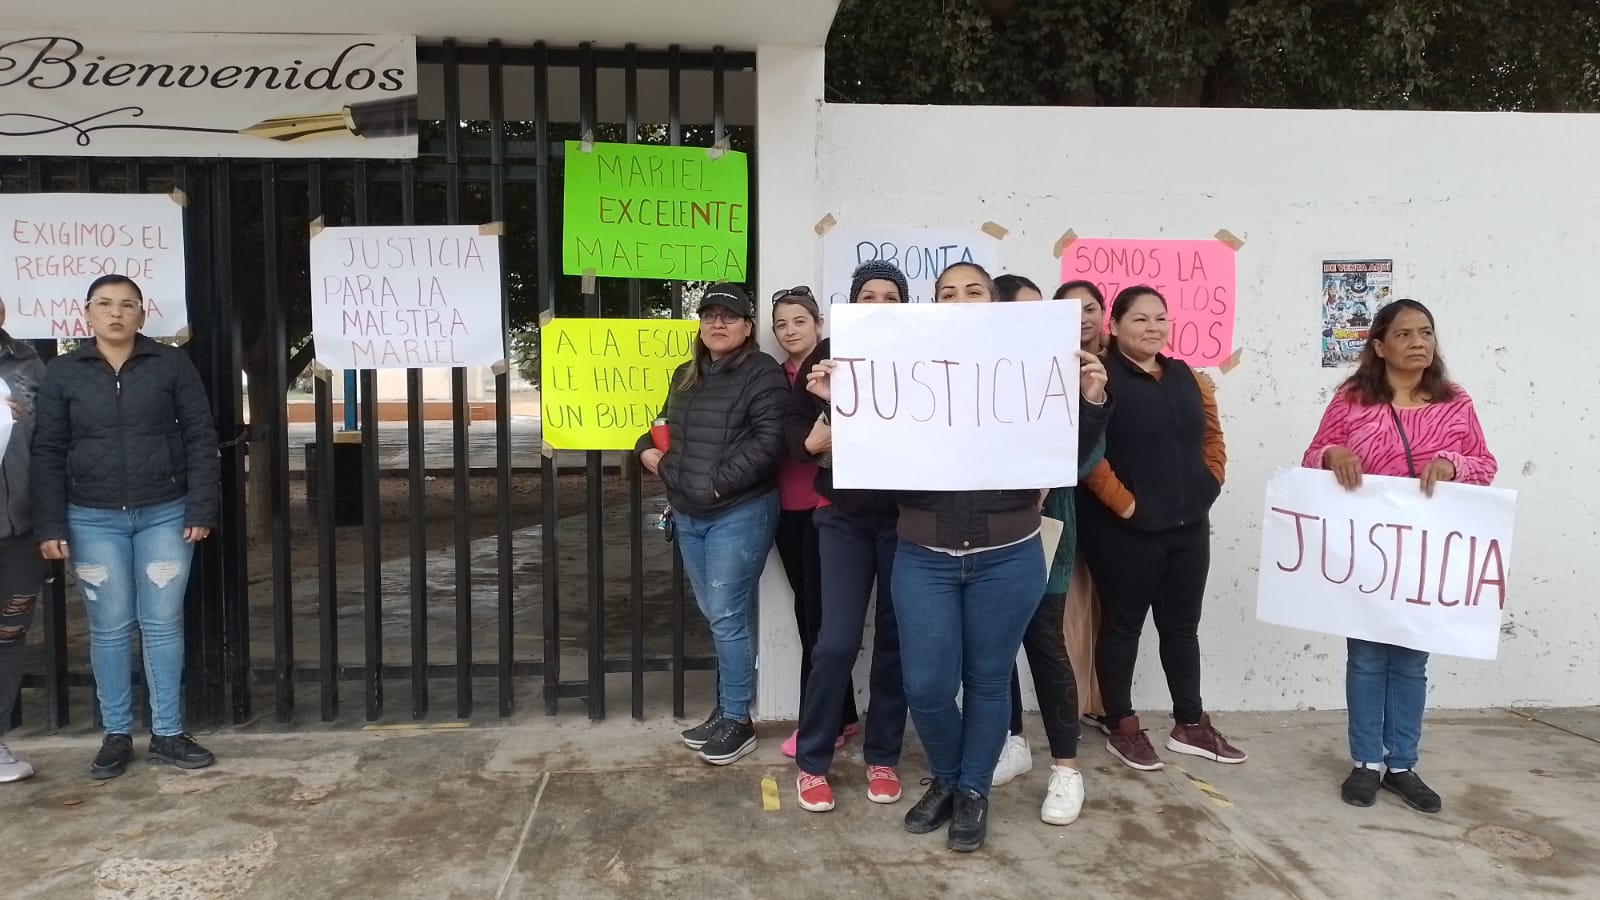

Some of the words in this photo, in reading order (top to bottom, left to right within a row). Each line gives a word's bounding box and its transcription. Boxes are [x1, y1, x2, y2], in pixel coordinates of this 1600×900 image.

[0, 36, 405, 92] Bienvenidos
[597, 154, 713, 192] MARIEL
[599, 196, 744, 234] EXCELENTE
[13, 219, 134, 248] EXIGIMOS
[142, 225, 170, 251] EL
[15, 255, 117, 281] REGRESO
[126, 257, 154, 280] DE
[338, 236, 485, 272] JUSTICIA
[576, 236, 745, 280] MAESTRA
[1075, 246, 1161, 278] SOMOS
[1177, 250, 1208, 282] LA
[1337, 263, 1368, 272] VENTA
[323, 274, 400, 307] PARA
[417, 275, 448, 307] LA
[1180, 285, 1227, 316] LOS
[17, 297, 46, 318] LA
[342, 308, 469, 338] MAESTRA
[351, 338, 465, 366] MARIEL
[556, 329, 578, 356] A
[589, 328, 621, 358] LA
[551, 365, 579, 392] LE
[593, 366, 656, 394] HACE
[832, 355, 1074, 428] JUSTICIA
[545, 403, 583, 429] UN
[1271, 506, 1506, 611] JUSTICIA
